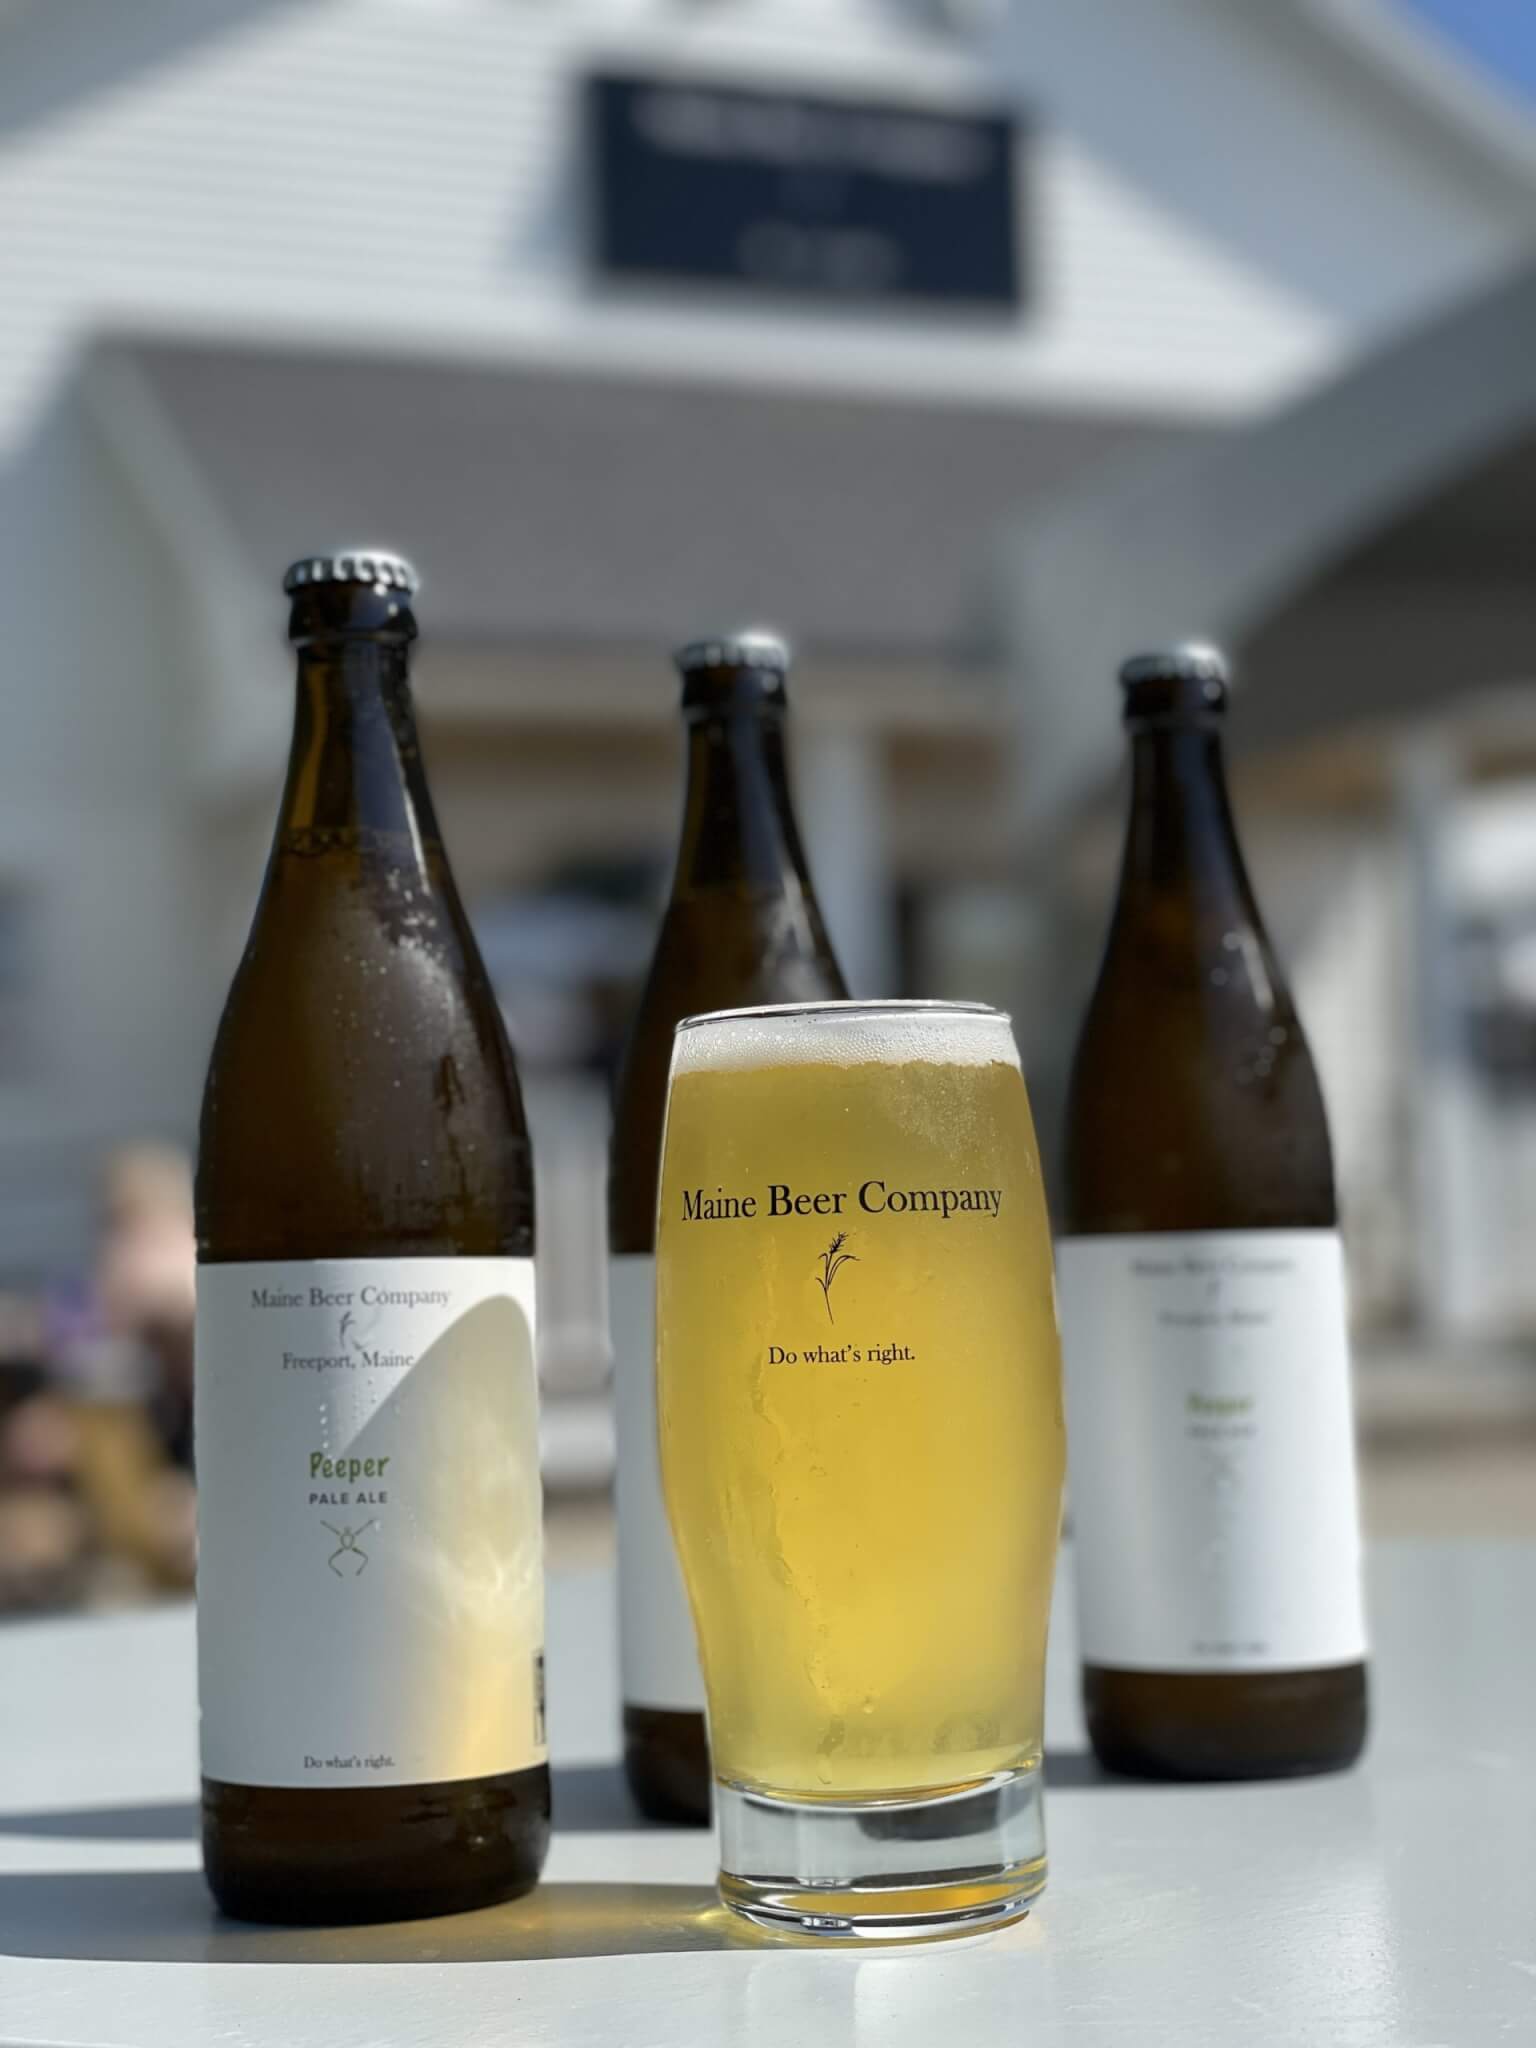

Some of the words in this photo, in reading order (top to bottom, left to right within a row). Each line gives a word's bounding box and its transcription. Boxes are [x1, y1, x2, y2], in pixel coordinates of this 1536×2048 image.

[681, 1188, 757, 1221] Maine
[767, 1184, 847, 1216] Beer
[858, 1180, 1002, 1219] Company
[251, 1289, 303, 1308] Maine
[309, 1288, 353, 1307] Beer
[360, 1286, 450, 1307] Company
[282, 1352, 356, 1372] Freeport,
[362, 1351, 415, 1369] Maine
[768, 1346, 797, 1364] Do
[803, 1344, 861, 1364] what's
[867, 1343, 916, 1365] right.
[309, 1451, 390, 1483] Peeper
[309, 1492, 349, 1505] PALE
[356, 1491, 388, 1504] ALE
[303, 1755, 323, 1769] Do
[325, 1754, 362, 1769] what's
[364, 1754, 396, 1769] right.
